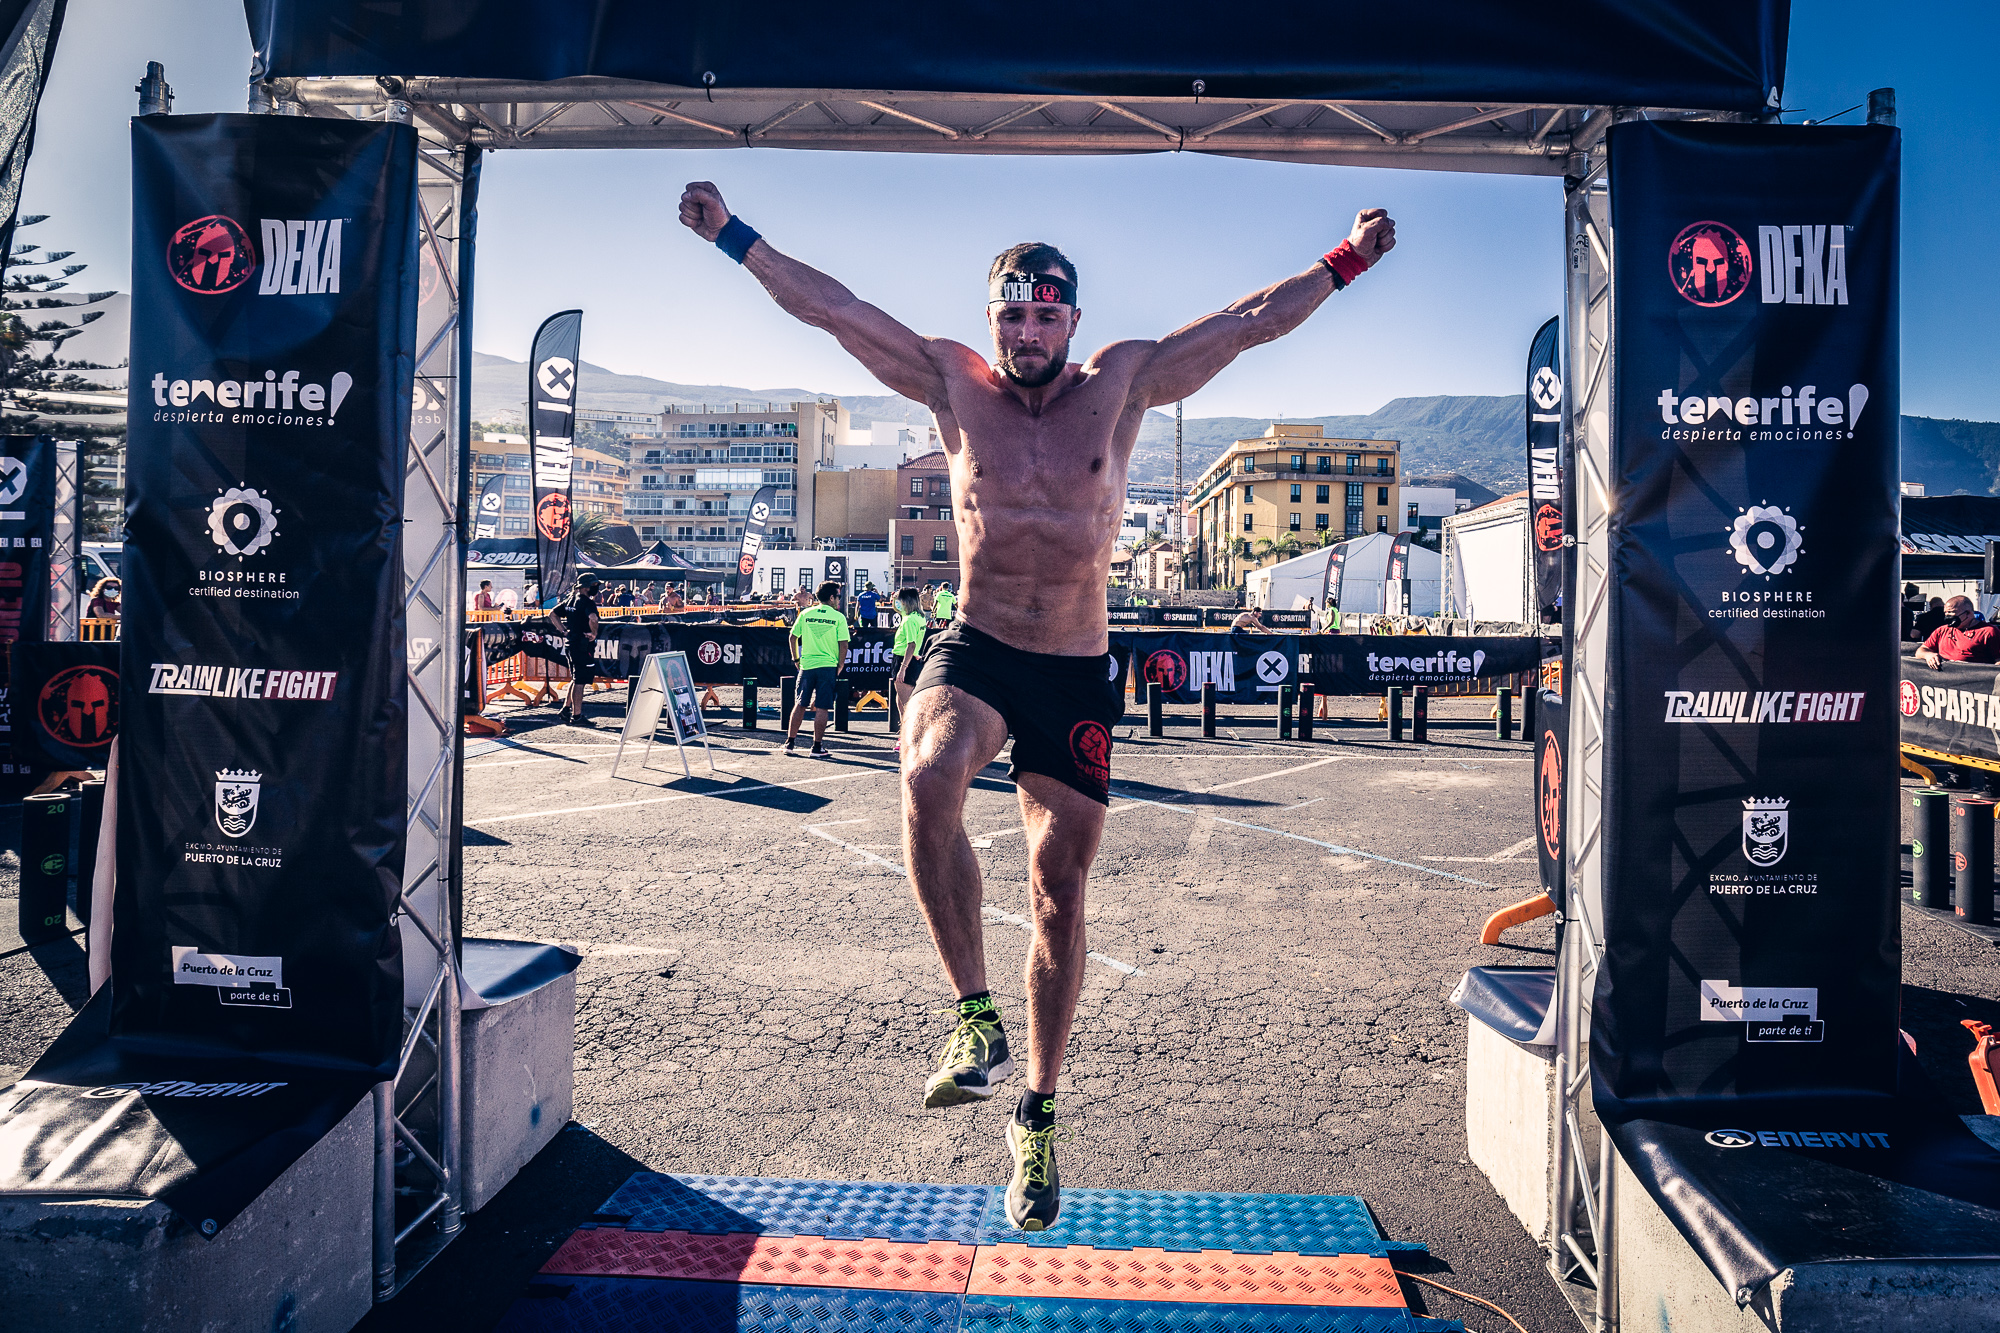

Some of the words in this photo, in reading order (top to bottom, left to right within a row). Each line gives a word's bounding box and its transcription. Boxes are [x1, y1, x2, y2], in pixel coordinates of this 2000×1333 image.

[259, 218, 342, 295] DEKA
[1758, 225, 1849, 305] DEKA
[1004, 282, 1032, 302] DEKA
[152, 369, 353, 426] tenerife!
[1658, 383, 1869, 439] tenerife!
[154, 410, 224, 424] despierta
[232, 412, 323, 426] emociones
[1661, 427, 1741, 442] despierta
[1750, 428, 1842, 441] emociones
[199, 570, 286, 583] BIOSPHERE
[189, 586, 231, 598] certified
[234, 587, 300, 599] destination
[1722, 591, 1812, 602] BIOSPHERE
[1171, 613, 1198, 622] SPARTAN
[1280, 614, 1306, 622] SPARTAN
[1708, 608, 1759, 618] certified
[1762, 608, 1825, 618] destination
[1189, 651, 1236, 692] DEKA
[1366, 650, 1486, 681] tenerife!
[1368, 673, 1415, 682] despierta
[1419, 674, 1471, 682] emociones
[47, 804, 65, 814] 20
[1956, 807, 1965, 816] 10
[216, 844, 270, 854] AYUNTAMIENTO
[185, 853, 225, 863] PUERTO
[226, 855, 239, 865] DE
[241, 856, 253, 866] LA
[254, 857, 282, 868] CRUZ
[1710, 874, 1742, 882] EXCMO.
[1744, 873, 1804, 881] AYUNTAMIENTO
[1709, 885, 1753, 895] PUERTO
[1756, 885, 1771, 894] DE
[1773, 885, 1786, 894] LA
[1788, 884, 1818, 894] CRUZ
[182, 962, 218, 974] Puerto
[220, 965, 233, 976] de
[235, 966, 245, 976] la
[247, 966, 274, 977] Cruz
[230, 992, 256, 1001] parte
[258, 992, 270, 1001] de
[272, 992, 280, 1001] ti
[1710, 997, 1750, 1009] Puerto
[1752, 998, 1767, 1009] de
[1768, 998, 1780, 1009] la
[1781, 998, 1809, 1009] Cruz
[1758, 1026, 1787, 1037] parte
[1789, 1025, 1802, 1036] de
[1804, 1025, 1812, 1036] ti
[151, 1080, 288, 1097] ENERVIT
[1756, 1130, 1890, 1148] ENERVIT
